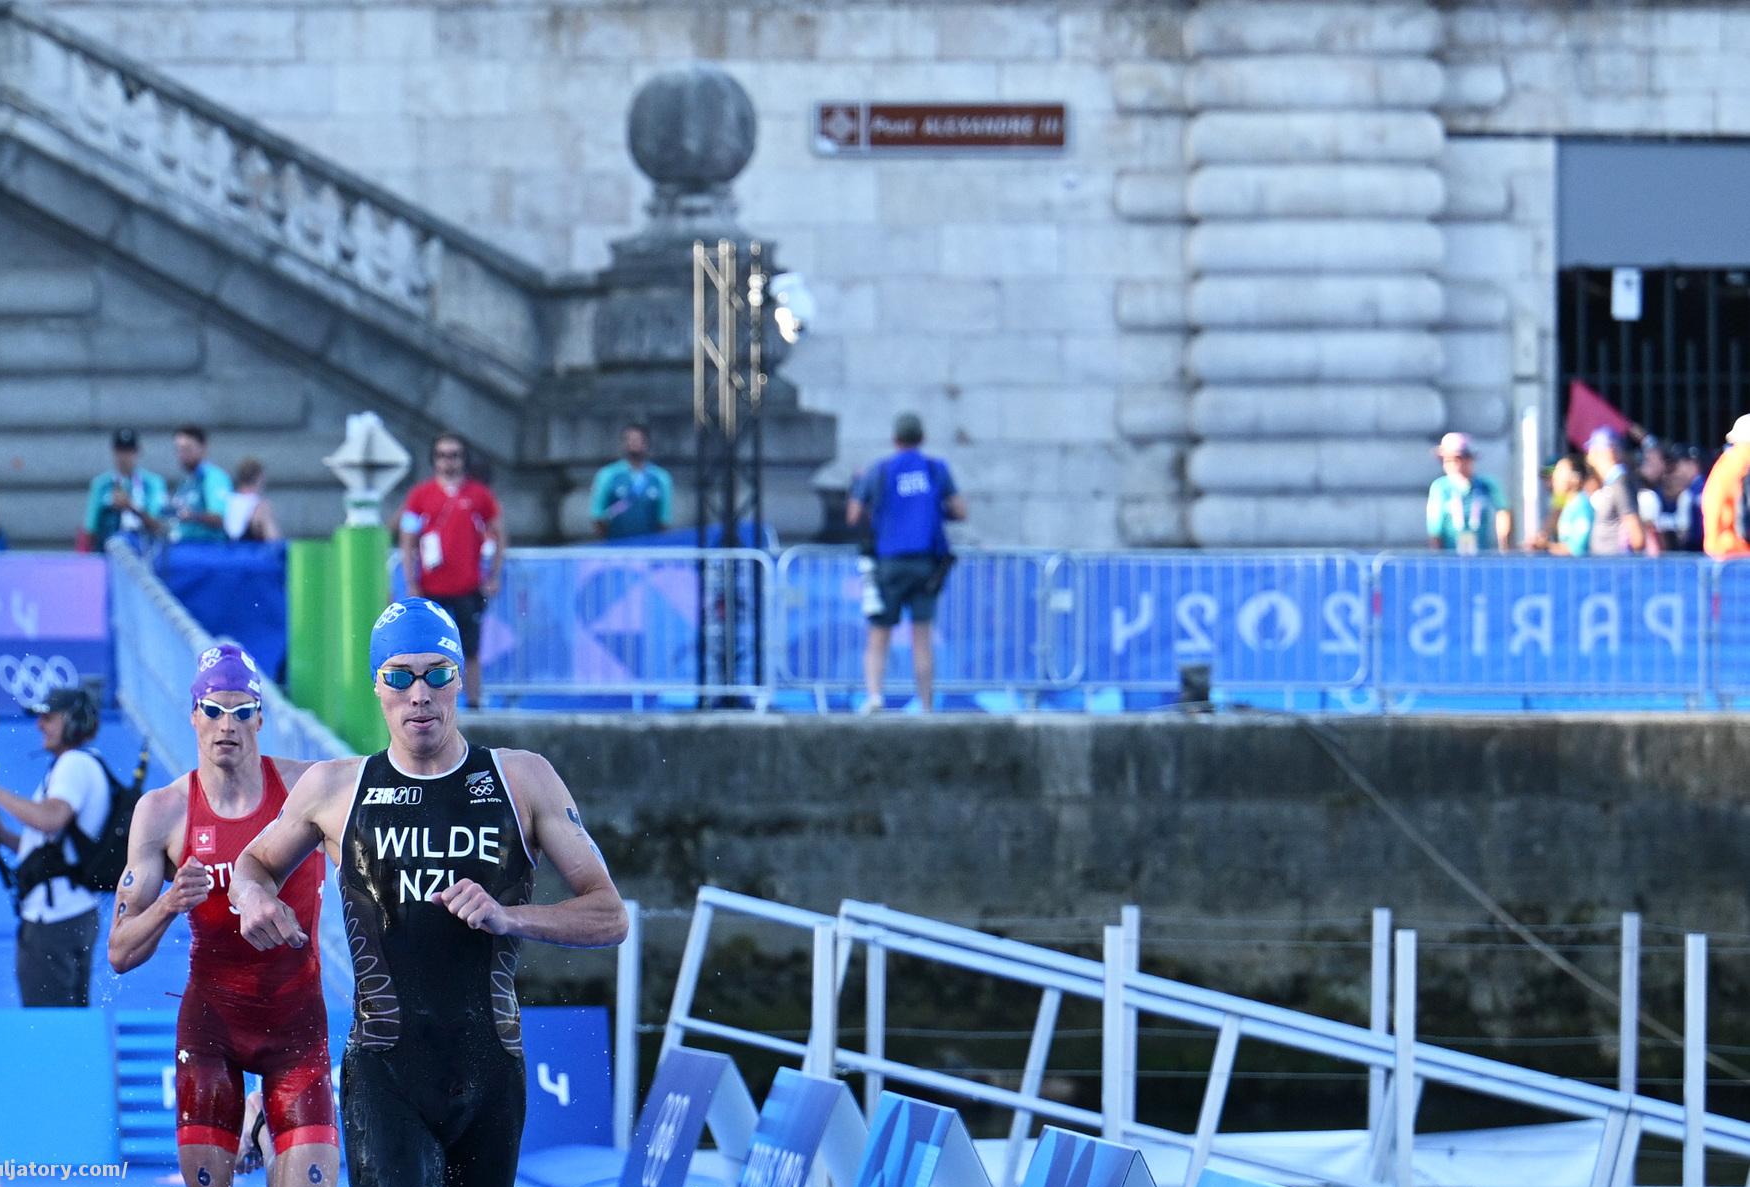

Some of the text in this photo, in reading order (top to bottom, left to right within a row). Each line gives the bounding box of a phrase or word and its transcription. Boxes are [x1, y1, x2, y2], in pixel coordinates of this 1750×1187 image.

[374, 826, 499, 864] WILDE
[198, 1167, 211, 1187] 6
[308, 1164, 322, 1184] 6
